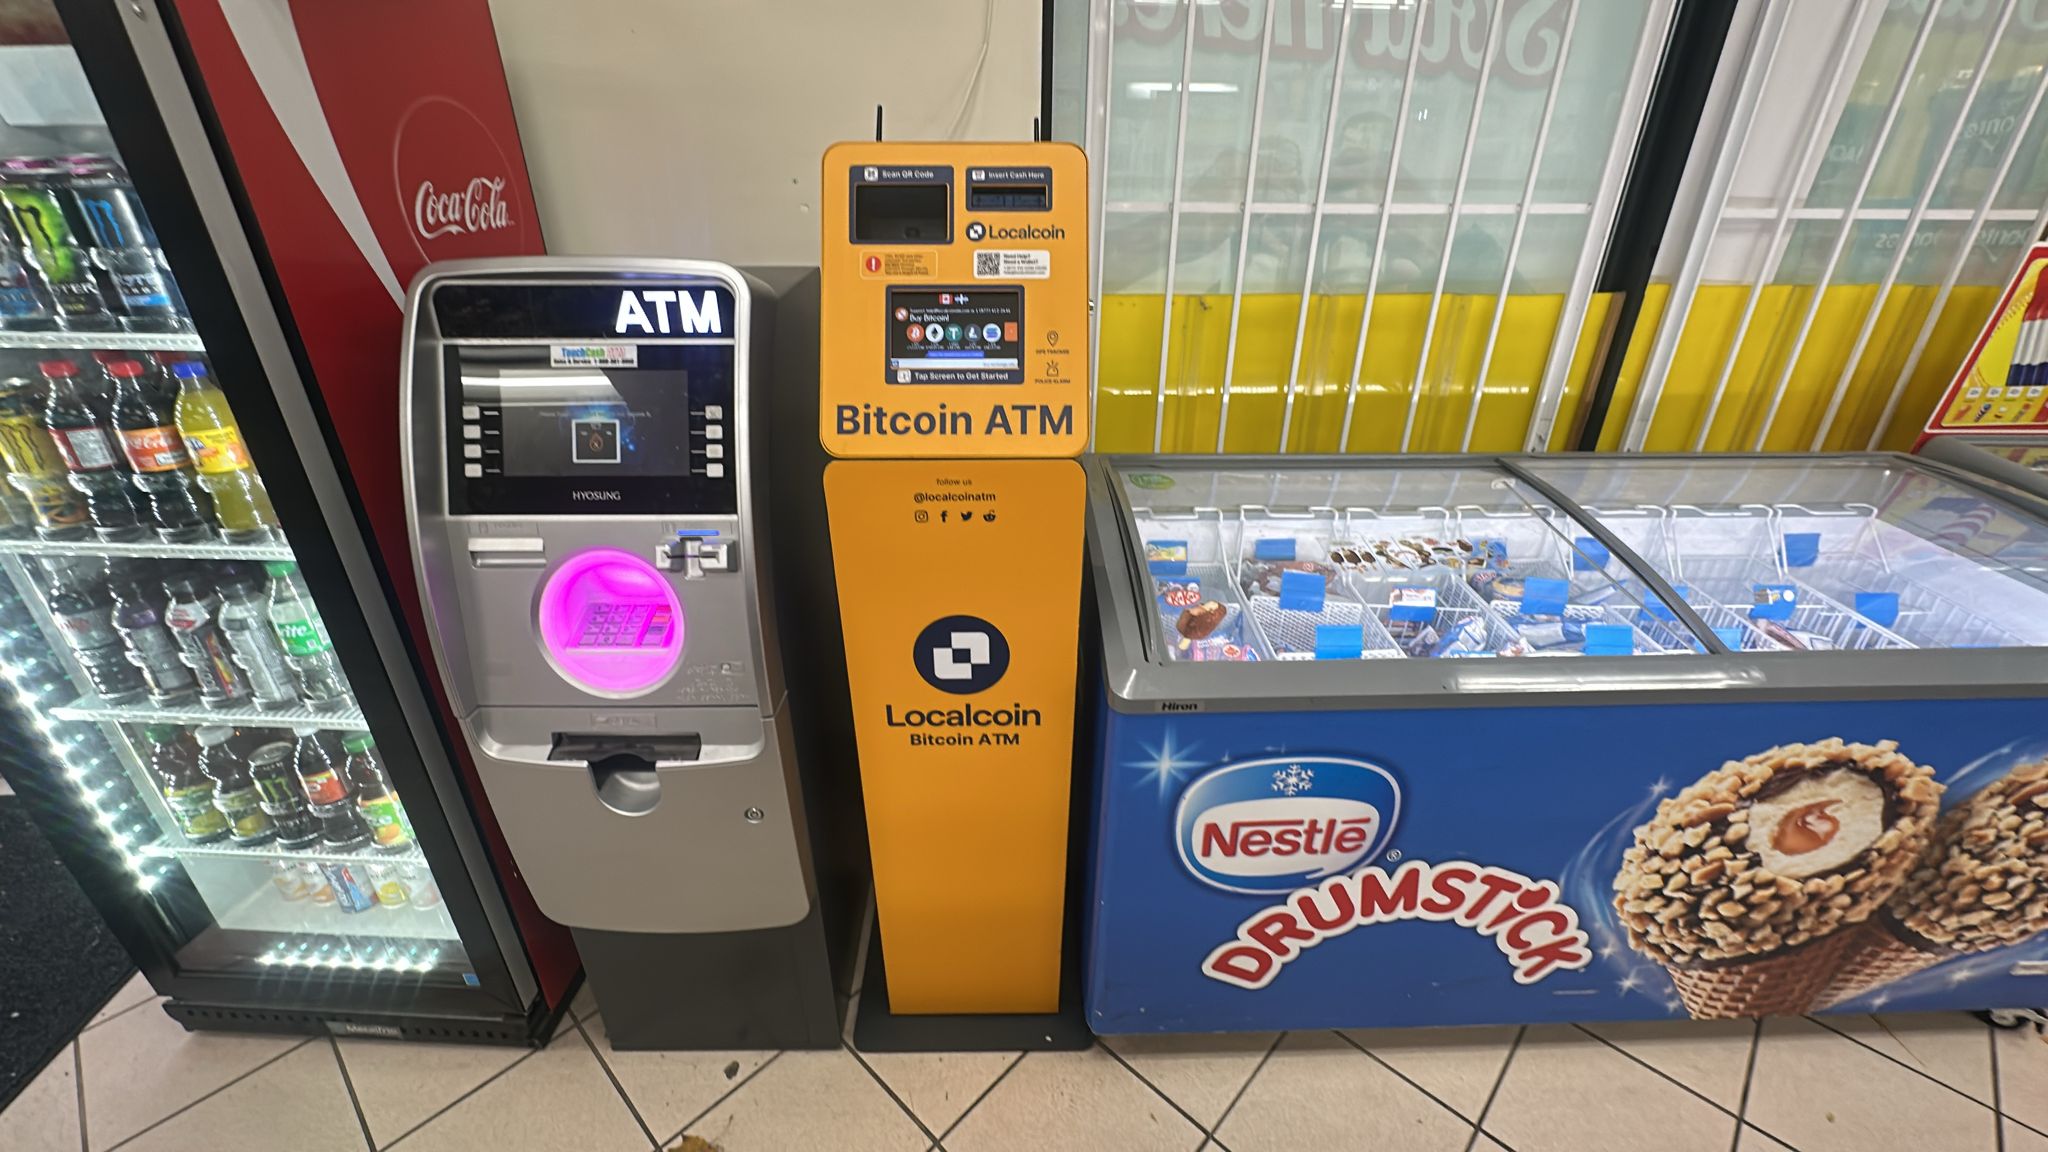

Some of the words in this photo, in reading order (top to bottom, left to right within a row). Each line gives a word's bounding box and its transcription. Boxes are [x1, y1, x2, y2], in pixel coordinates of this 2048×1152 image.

[882, 170, 900, 179] Scan
[902, 170, 914, 179] QR
[914, 170, 934, 179] Code
[988, 171, 1008, 179] Insert
[1009, 171, 1028, 179] Cash
[1028, 171, 1045, 179] Here
[415, 176, 507, 239] Coca-Cola
[989, 224, 1065, 240] Localcoin
[615, 290, 722, 333] ATM
[915, 372, 928, 380] Tap
[930, 372, 955, 380] Screen
[957, 372, 965, 380] to
[966, 372, 979, 380] Get
[980, 372, 1008, 380] Started
[837, 403, 972, 435] Bitcoin
[984, 405, 1073, 435] ATM
[936, 478, 960, 486] follow
[572, 490, 621, 500] HYOSUNG
[914, 492, 996, 504] @localcoinatm
[1161, 702, 1198, 711] Hiron
[886, 703, 1041, 727] Localcoin
[910, 733, 973, 746] Bitcoin
[978, 733, 1020, 745] ATM
[1201, 817, 1371, 858] Nestlé
